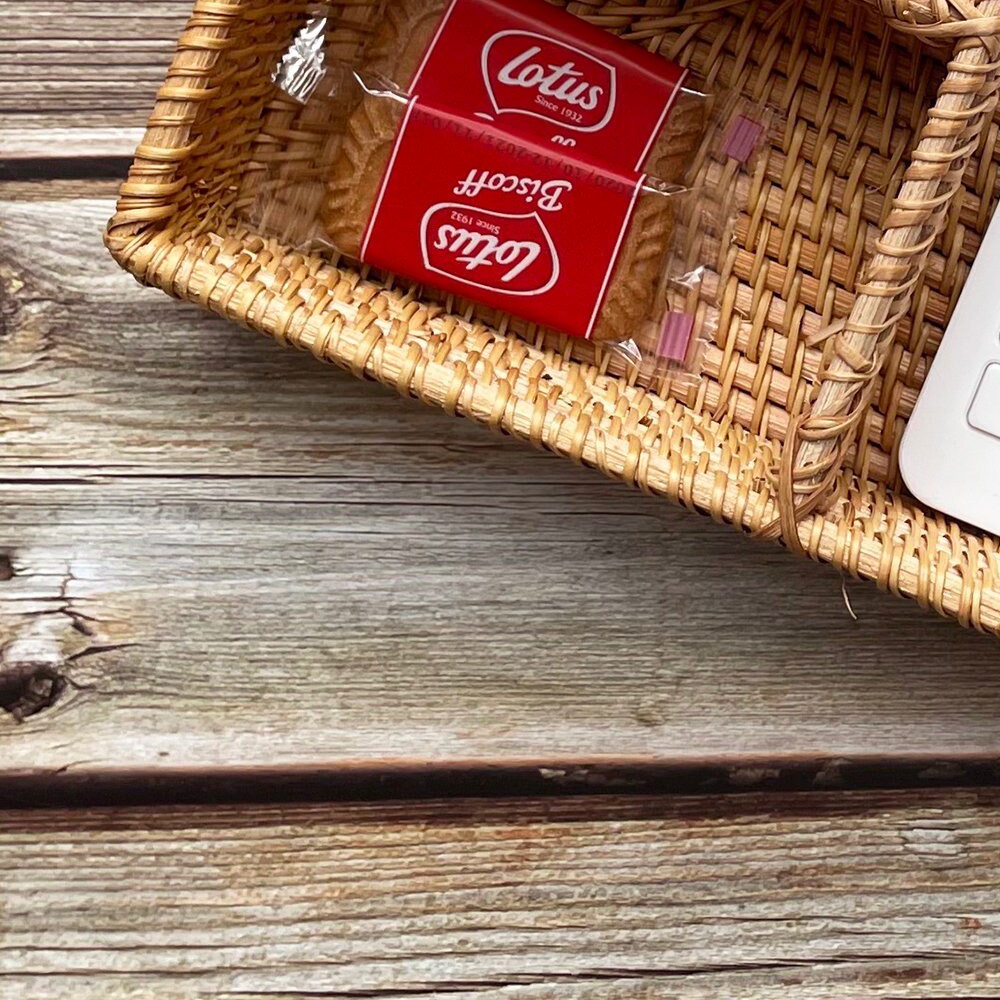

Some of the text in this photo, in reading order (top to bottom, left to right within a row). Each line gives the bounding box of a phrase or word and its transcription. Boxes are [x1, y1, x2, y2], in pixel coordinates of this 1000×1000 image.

[497, 46, 604, 111] Lotus
[533, 94, 583, 124] Since 1932
[453, 168, 573, 212] Biscoff
[450, 210, 501, 236] Since 1932
[433, 224, 541, 282] Lotus
